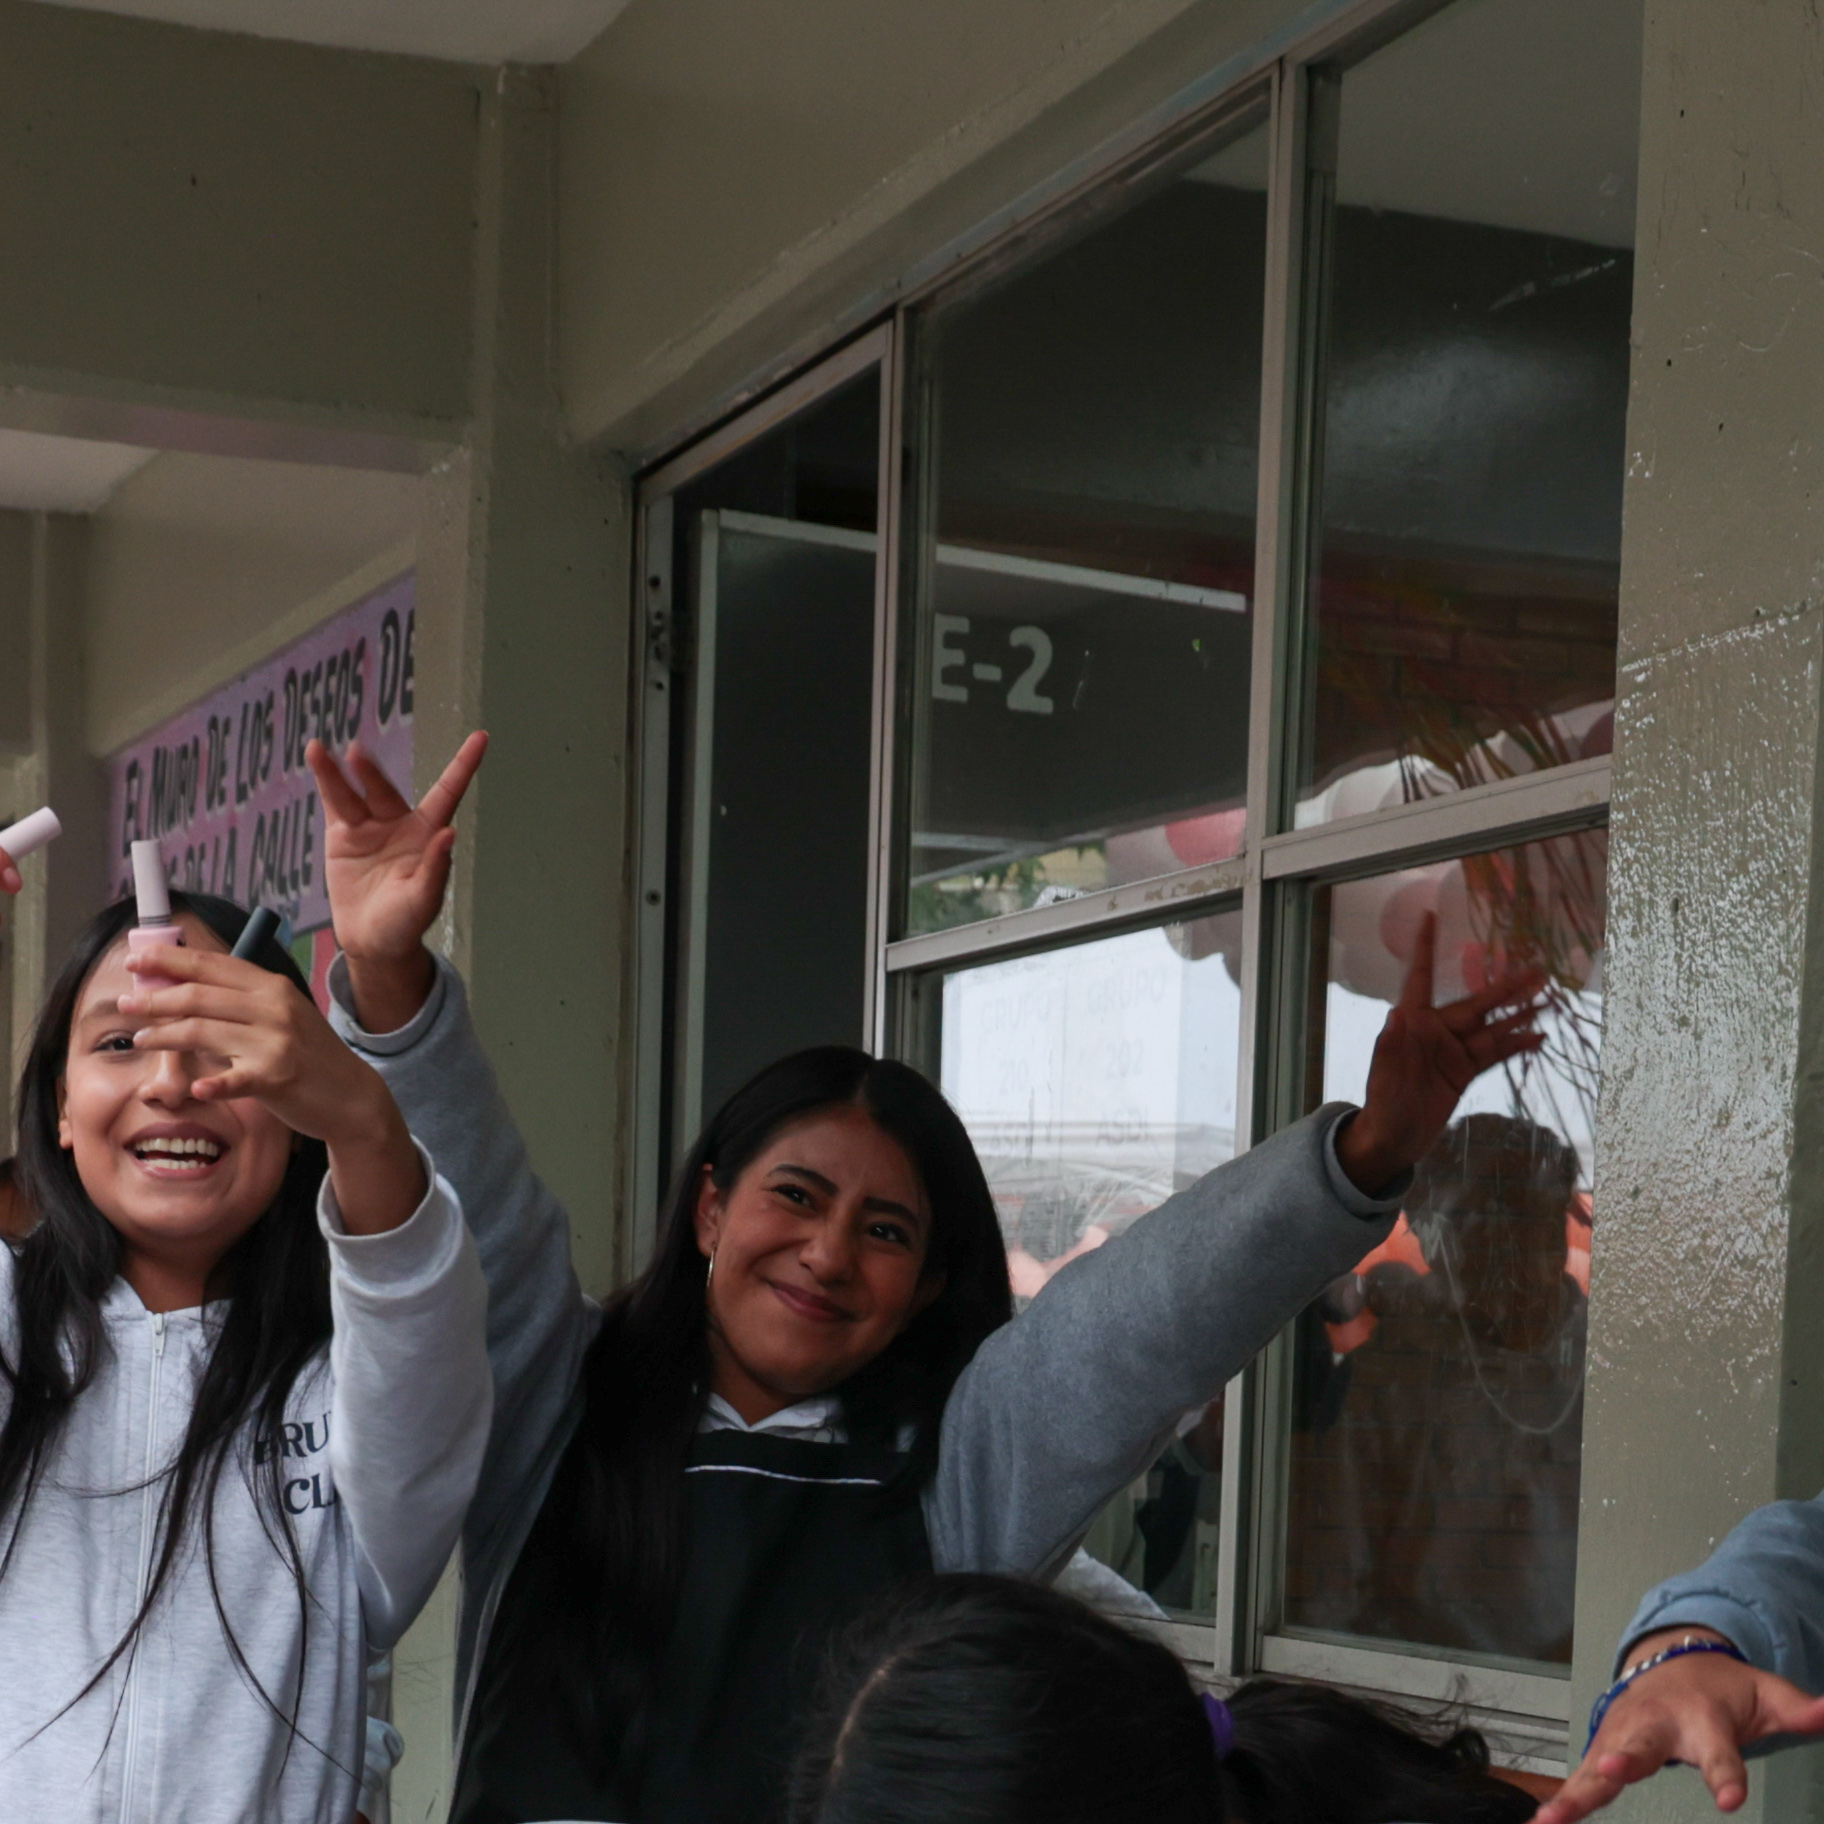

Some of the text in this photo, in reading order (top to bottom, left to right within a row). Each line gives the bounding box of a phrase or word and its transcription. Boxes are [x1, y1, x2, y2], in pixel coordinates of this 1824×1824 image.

[932, 613, 1053, 714] E-2
[149, 735, 200, 840] MURO
[207, 714, 232, 812] DE
[236, 691, 275, 806] LOS
[282, 636, 366, 773] DESEOS
[249, 791, 317, 906] CALLE
[282, 1473, 341, 1515] CL
